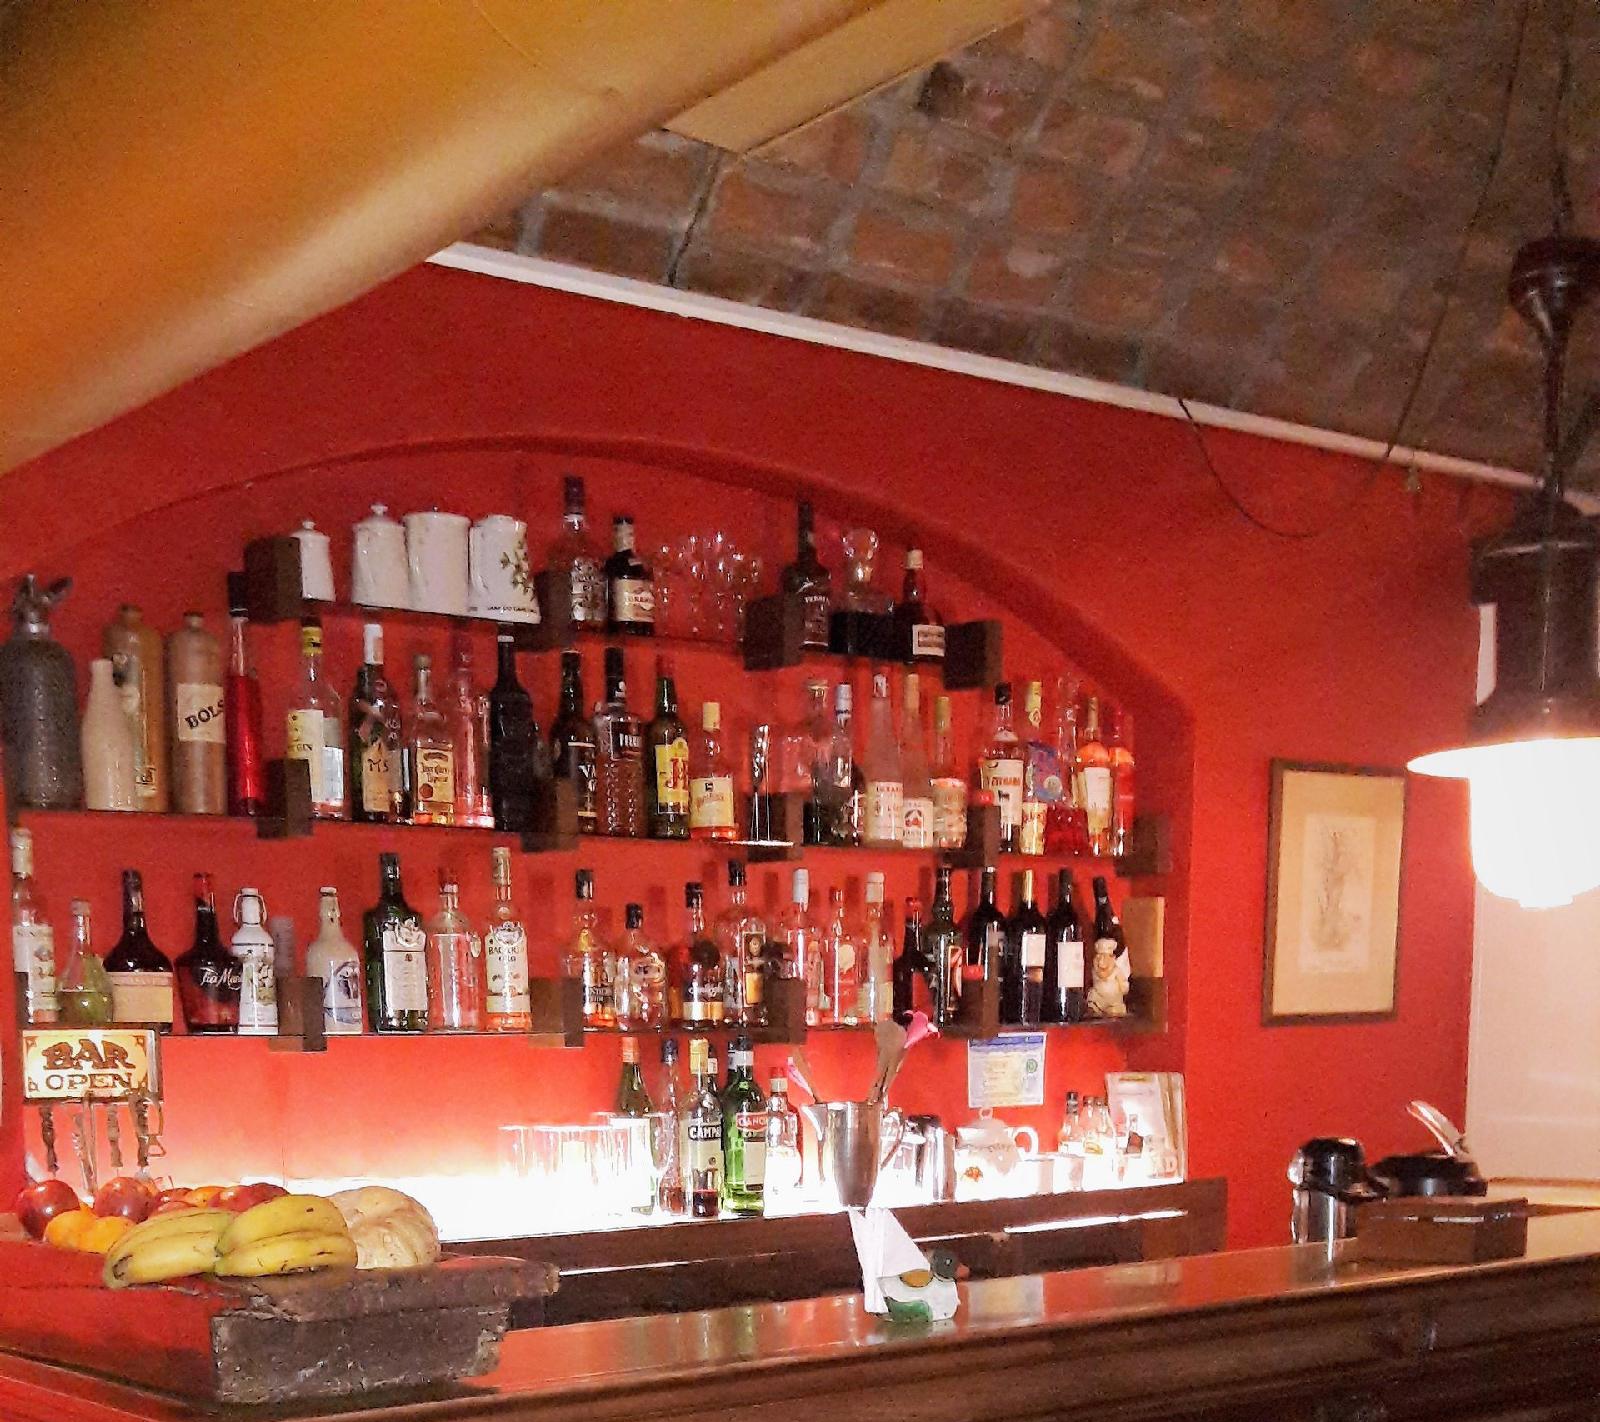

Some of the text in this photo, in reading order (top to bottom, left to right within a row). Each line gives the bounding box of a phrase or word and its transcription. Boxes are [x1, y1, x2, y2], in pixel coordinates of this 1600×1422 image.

[184, 699, 224, 730] BOLS
[42, 1038, 136, 1070] BAR
[45, 1072, 133, 1091] OPEN
